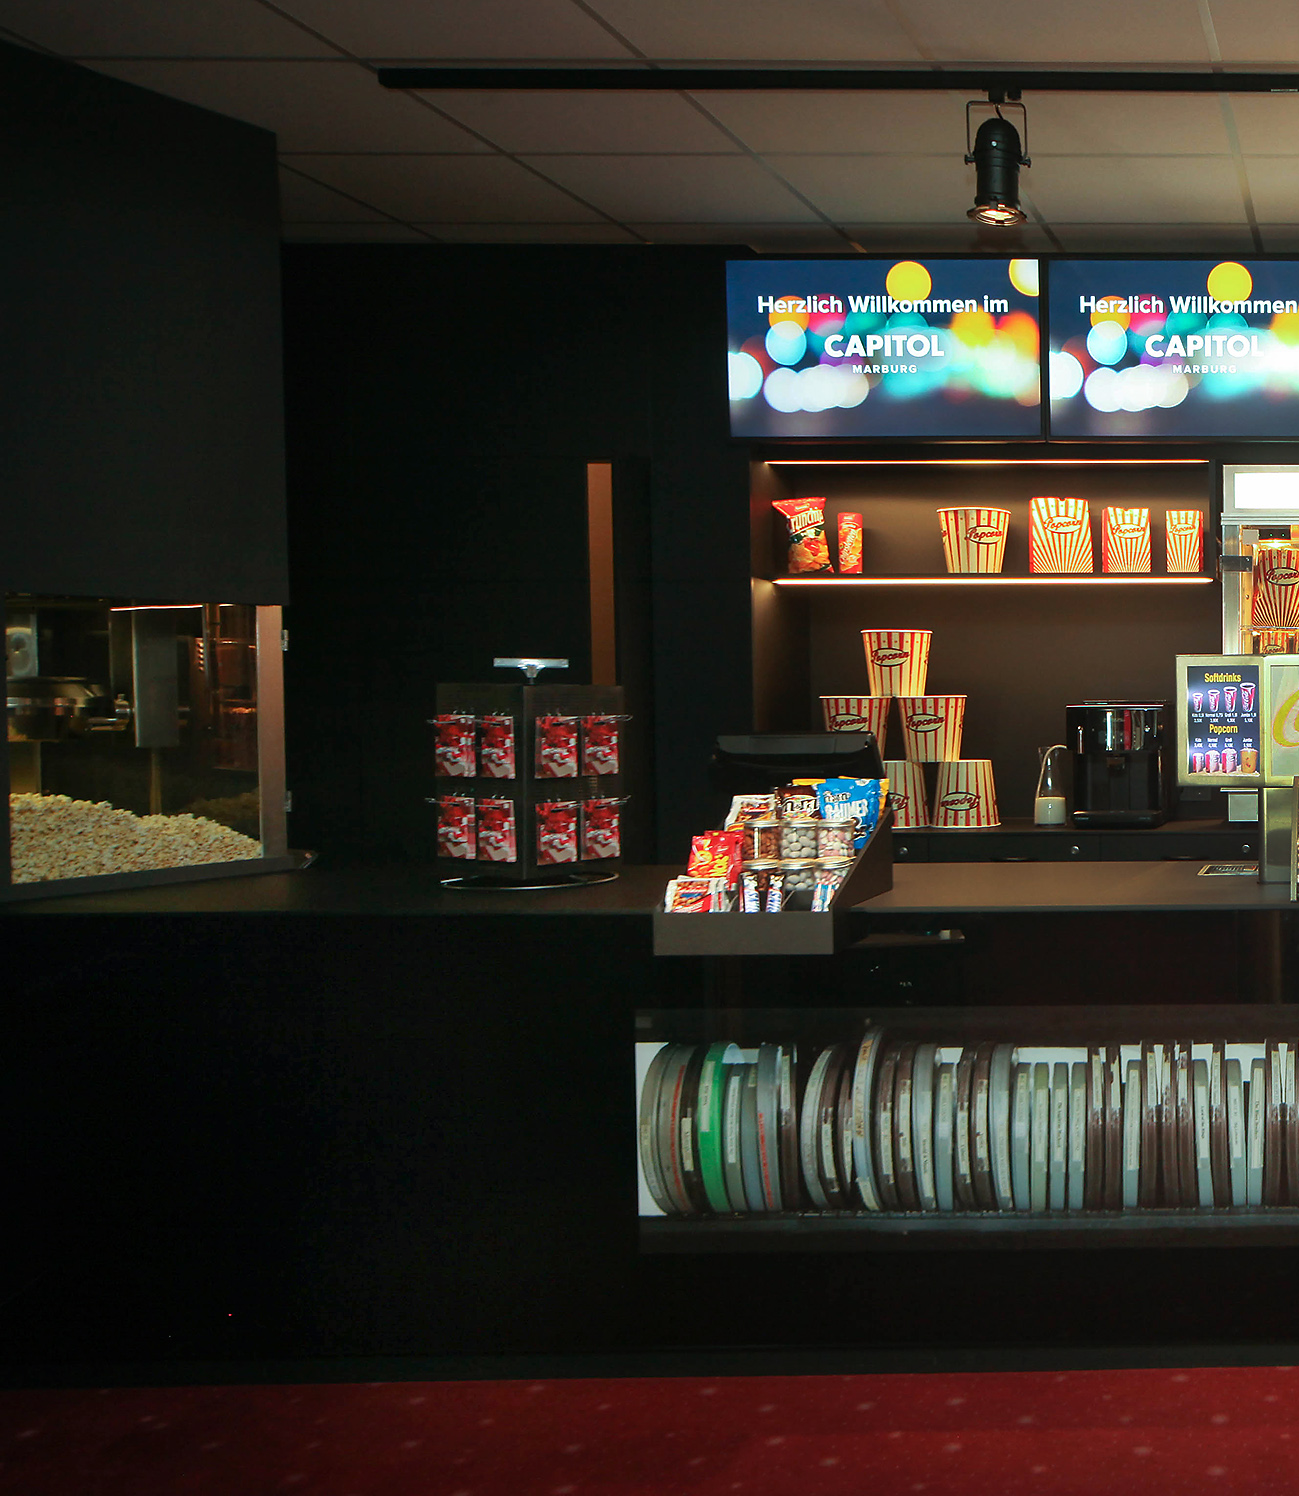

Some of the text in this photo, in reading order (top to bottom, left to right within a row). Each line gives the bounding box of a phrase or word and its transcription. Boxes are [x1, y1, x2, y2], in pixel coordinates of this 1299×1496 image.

[757, 295, 1009, 314] Herzlich Willkommen im
[1079, 295, 1164, 314] Herzlich
[1168, 295, 1299, 314] Willkommen
[824, 333, 945, 358] CAPITOL
[1145, 333, 1265, 358] CAPITOL
[852, 364, 918, 374] MARBURG
[1172, 364, 1237, 374] MARBURG
[1204, 672, 1242, 683] Softdrinks
[1209, 724, 1238, 735] Popcorn
